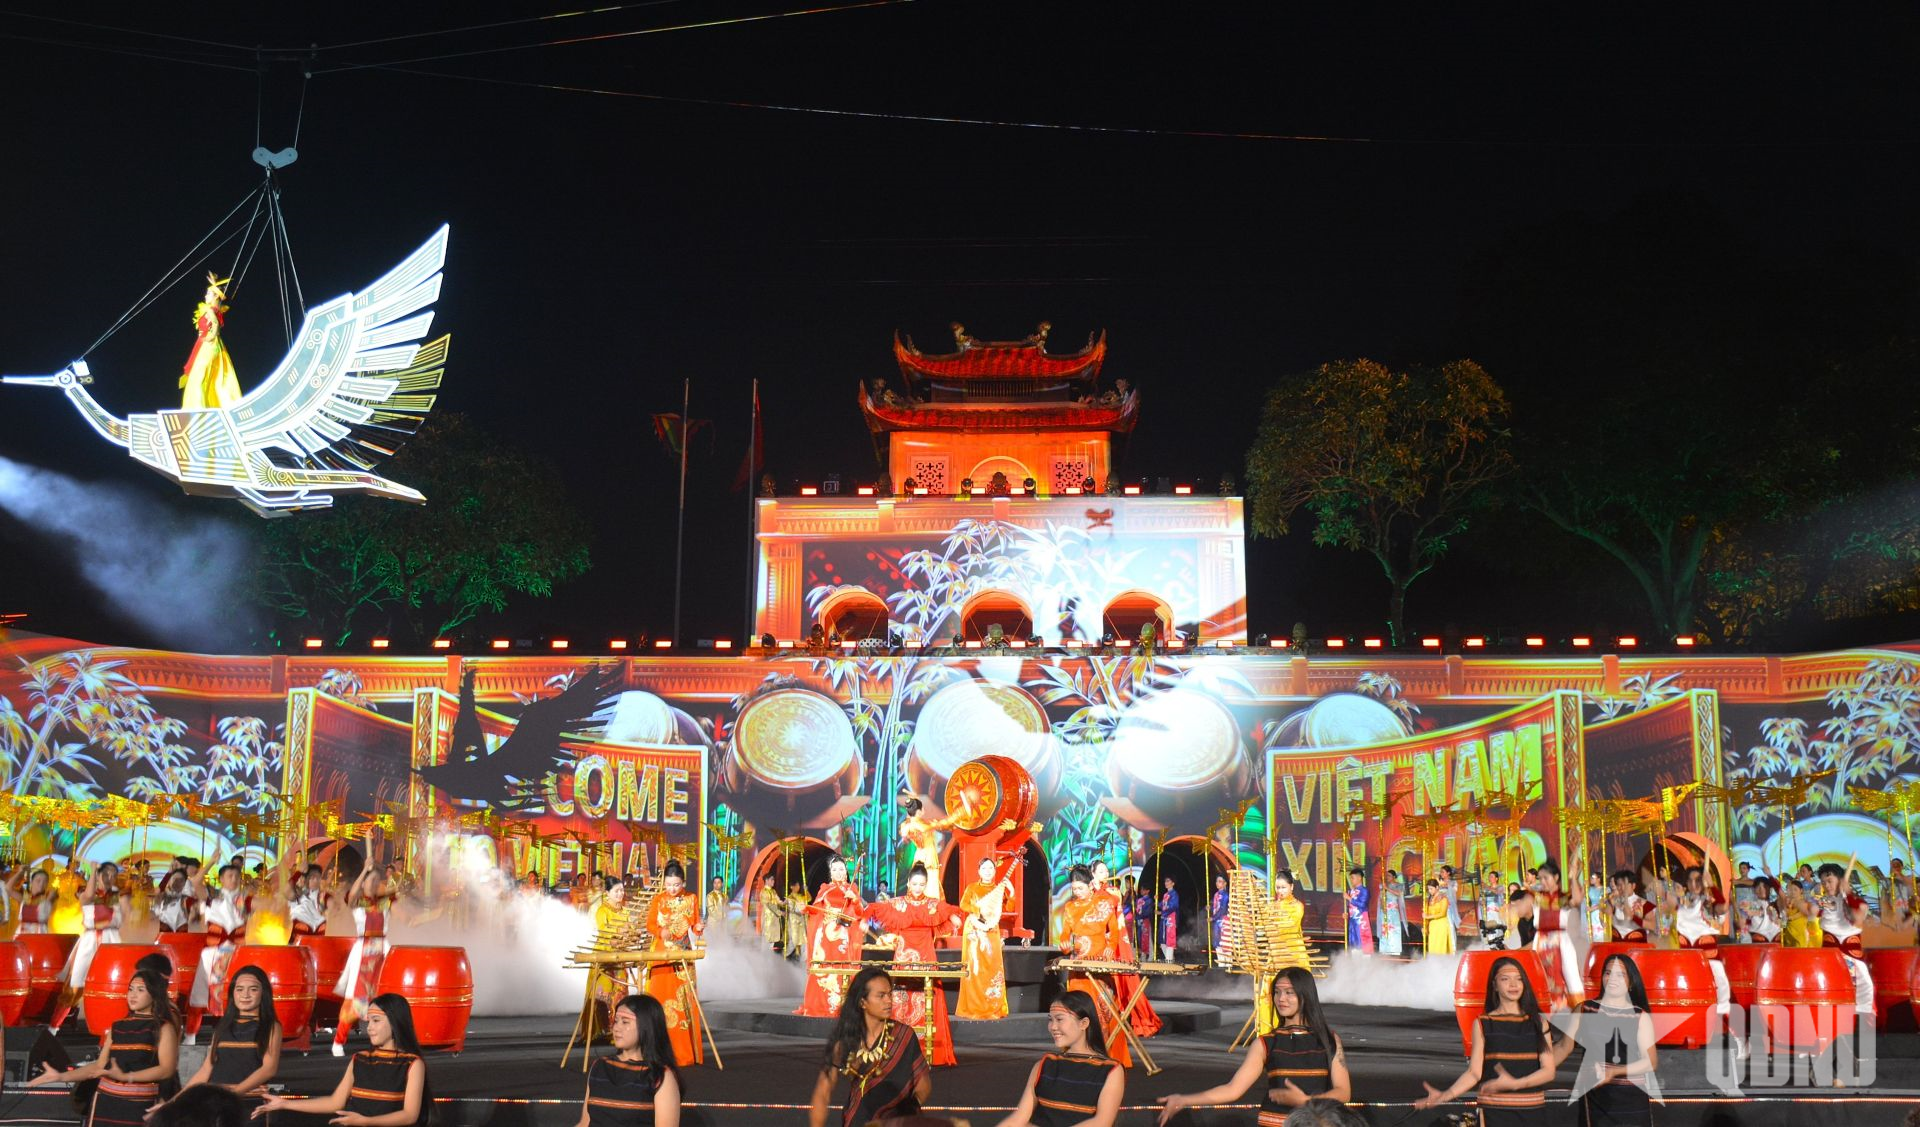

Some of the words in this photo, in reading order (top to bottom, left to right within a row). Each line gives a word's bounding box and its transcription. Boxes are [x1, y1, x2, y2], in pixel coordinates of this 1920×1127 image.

[1282, 754, 1396, 832] VIỆT
[1412, 722, 1544, 816] NAM
[1280, 838, 1367, 895] XIN
